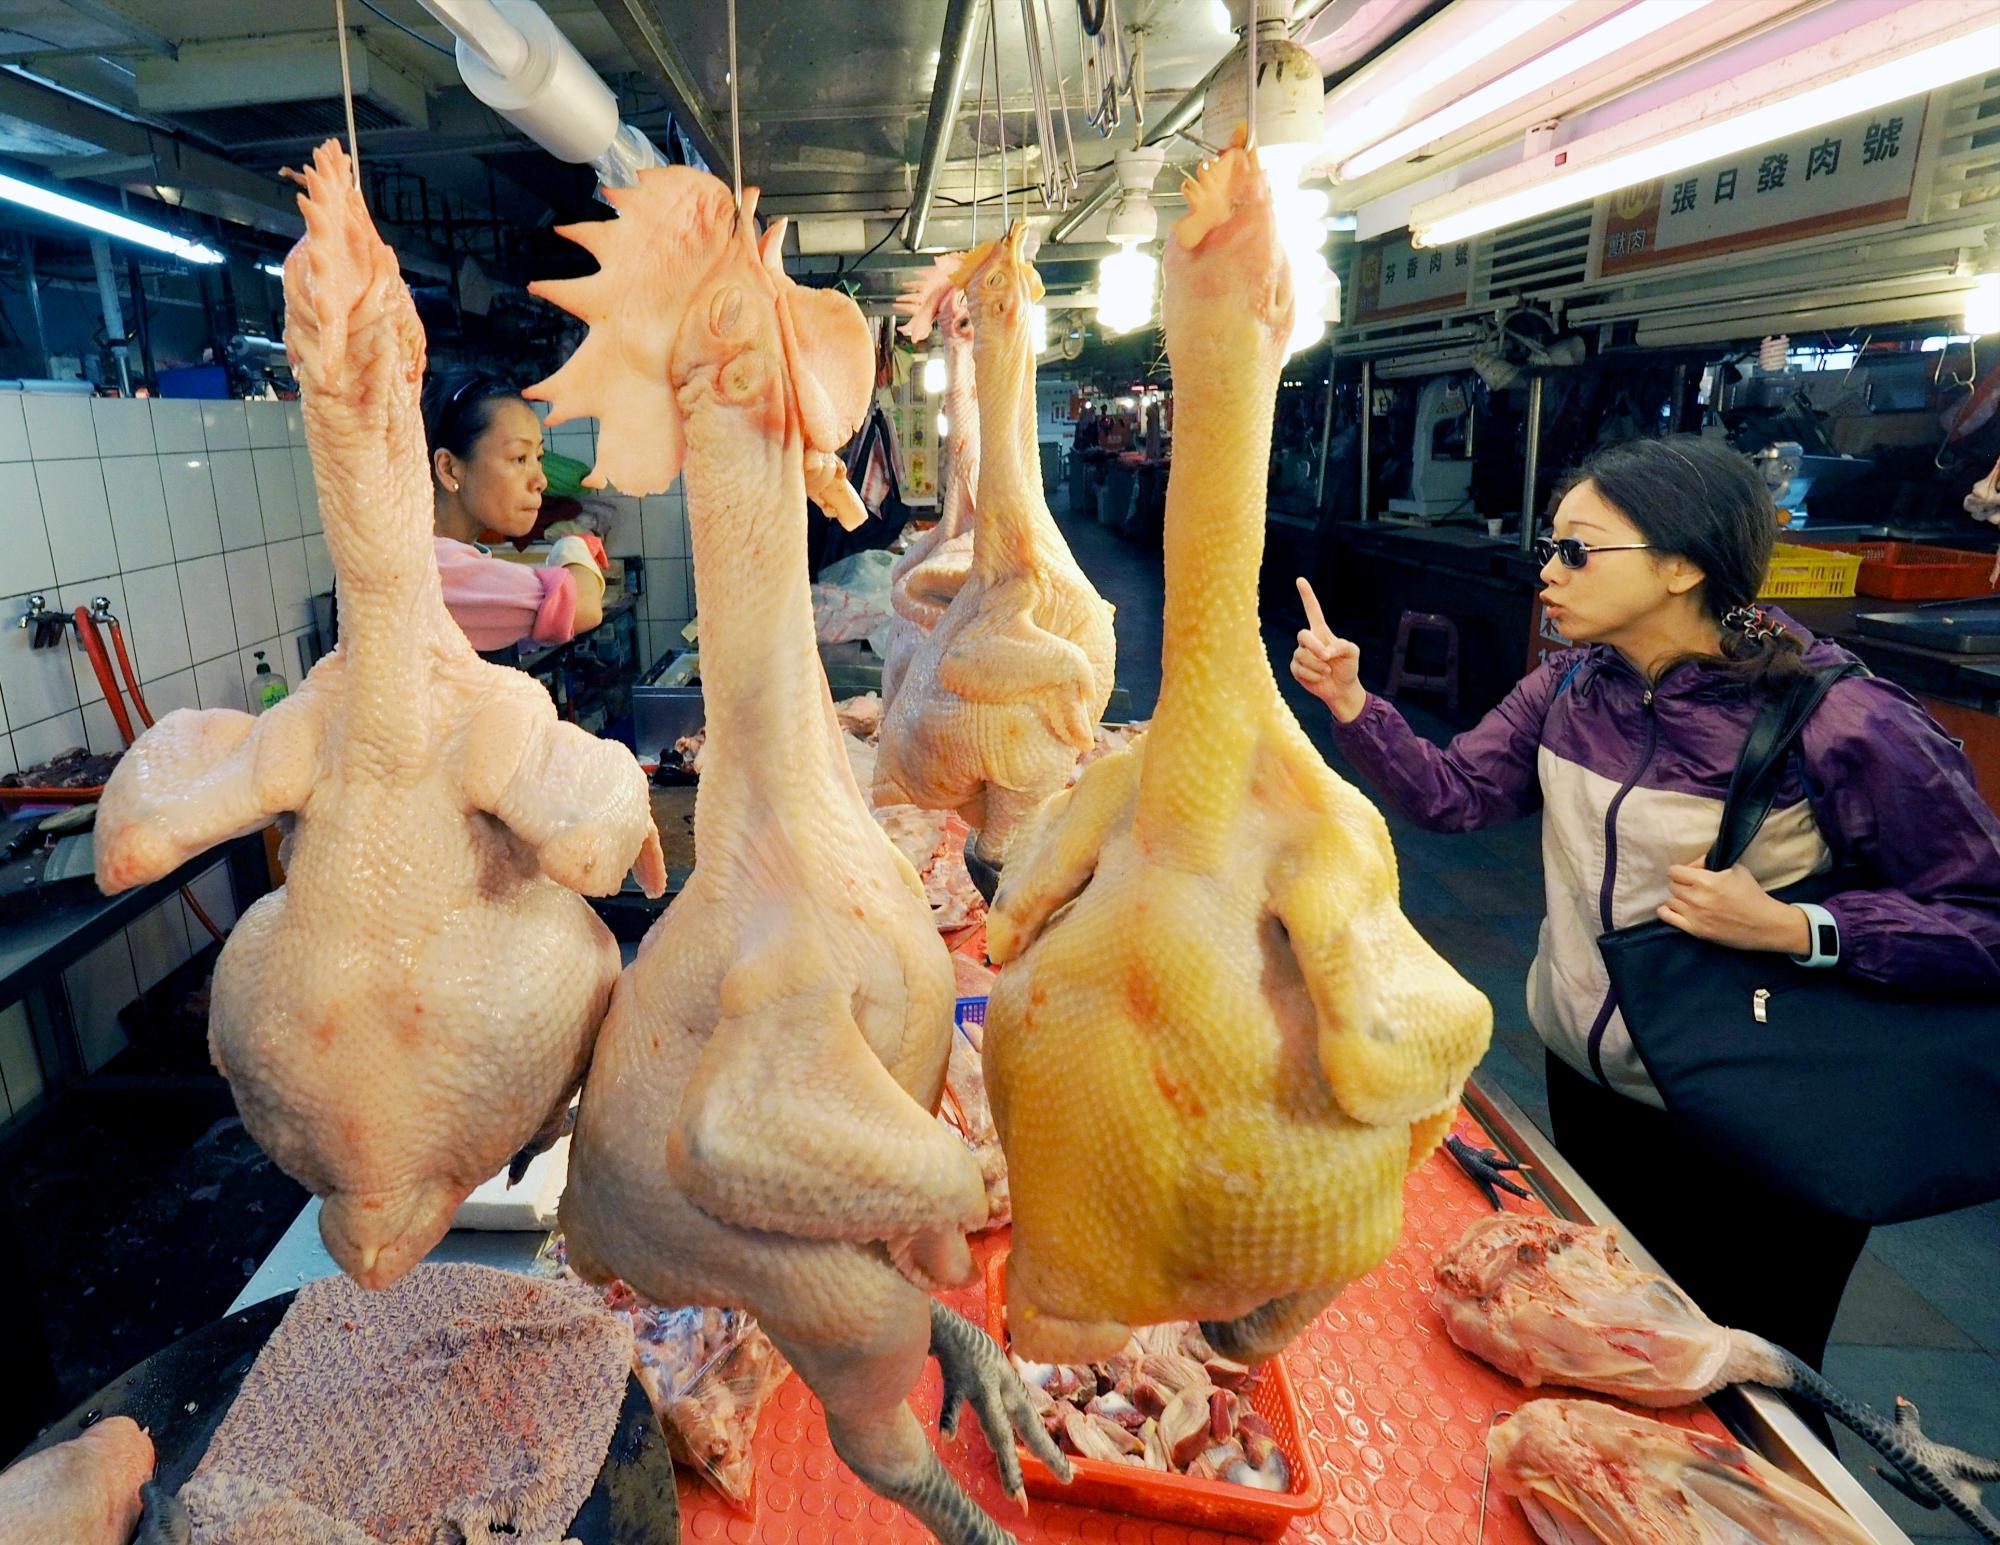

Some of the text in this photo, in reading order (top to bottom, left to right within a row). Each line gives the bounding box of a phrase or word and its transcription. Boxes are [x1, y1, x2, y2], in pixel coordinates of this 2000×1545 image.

[1671, 117, 1904, 215] 張日發肉號
